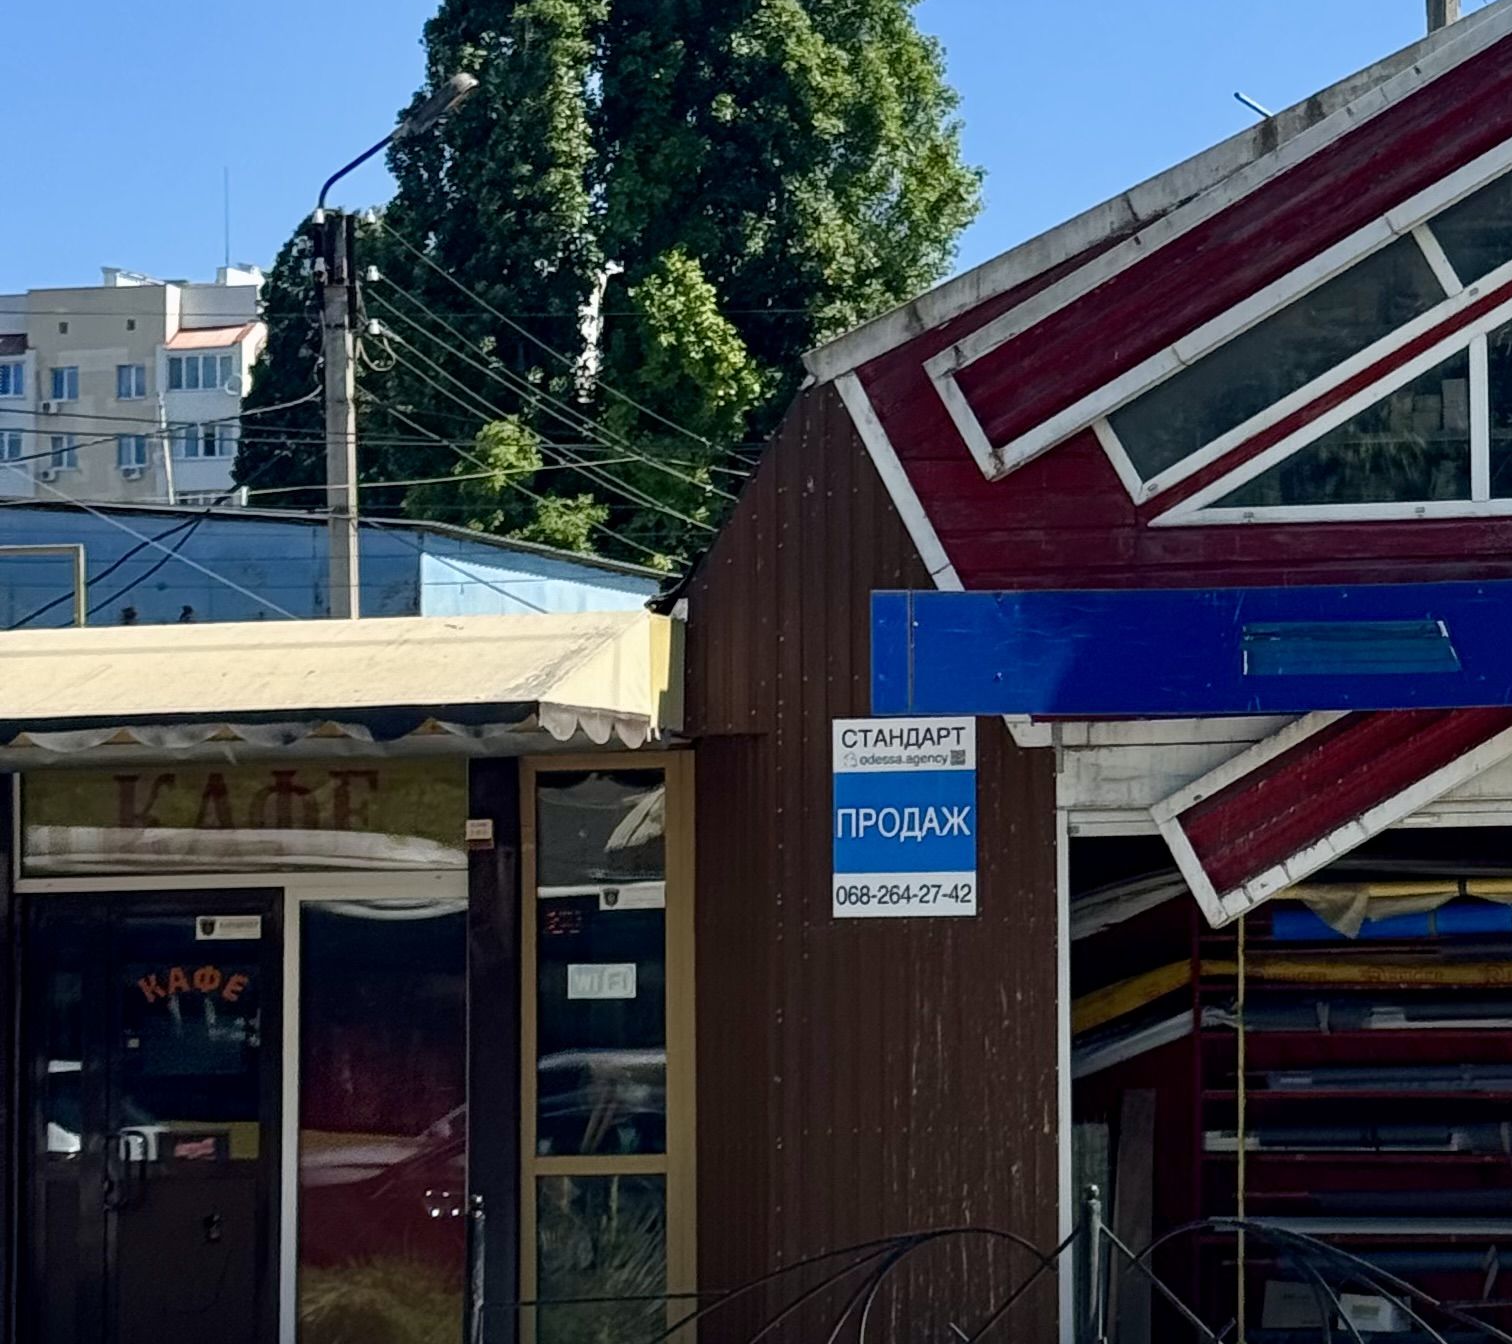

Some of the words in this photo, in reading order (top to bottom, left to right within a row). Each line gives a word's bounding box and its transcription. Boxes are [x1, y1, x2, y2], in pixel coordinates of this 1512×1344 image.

[841, 726, 966, 750] СТАНДАРТ
[859, 753, 949, 767] odessa.agency
[836, 806, 971, 843] ПРОДАЖ
[836, 883, 972, 906] 068-264-27-42
[137, 964, 250, 1003] КАФЕ
